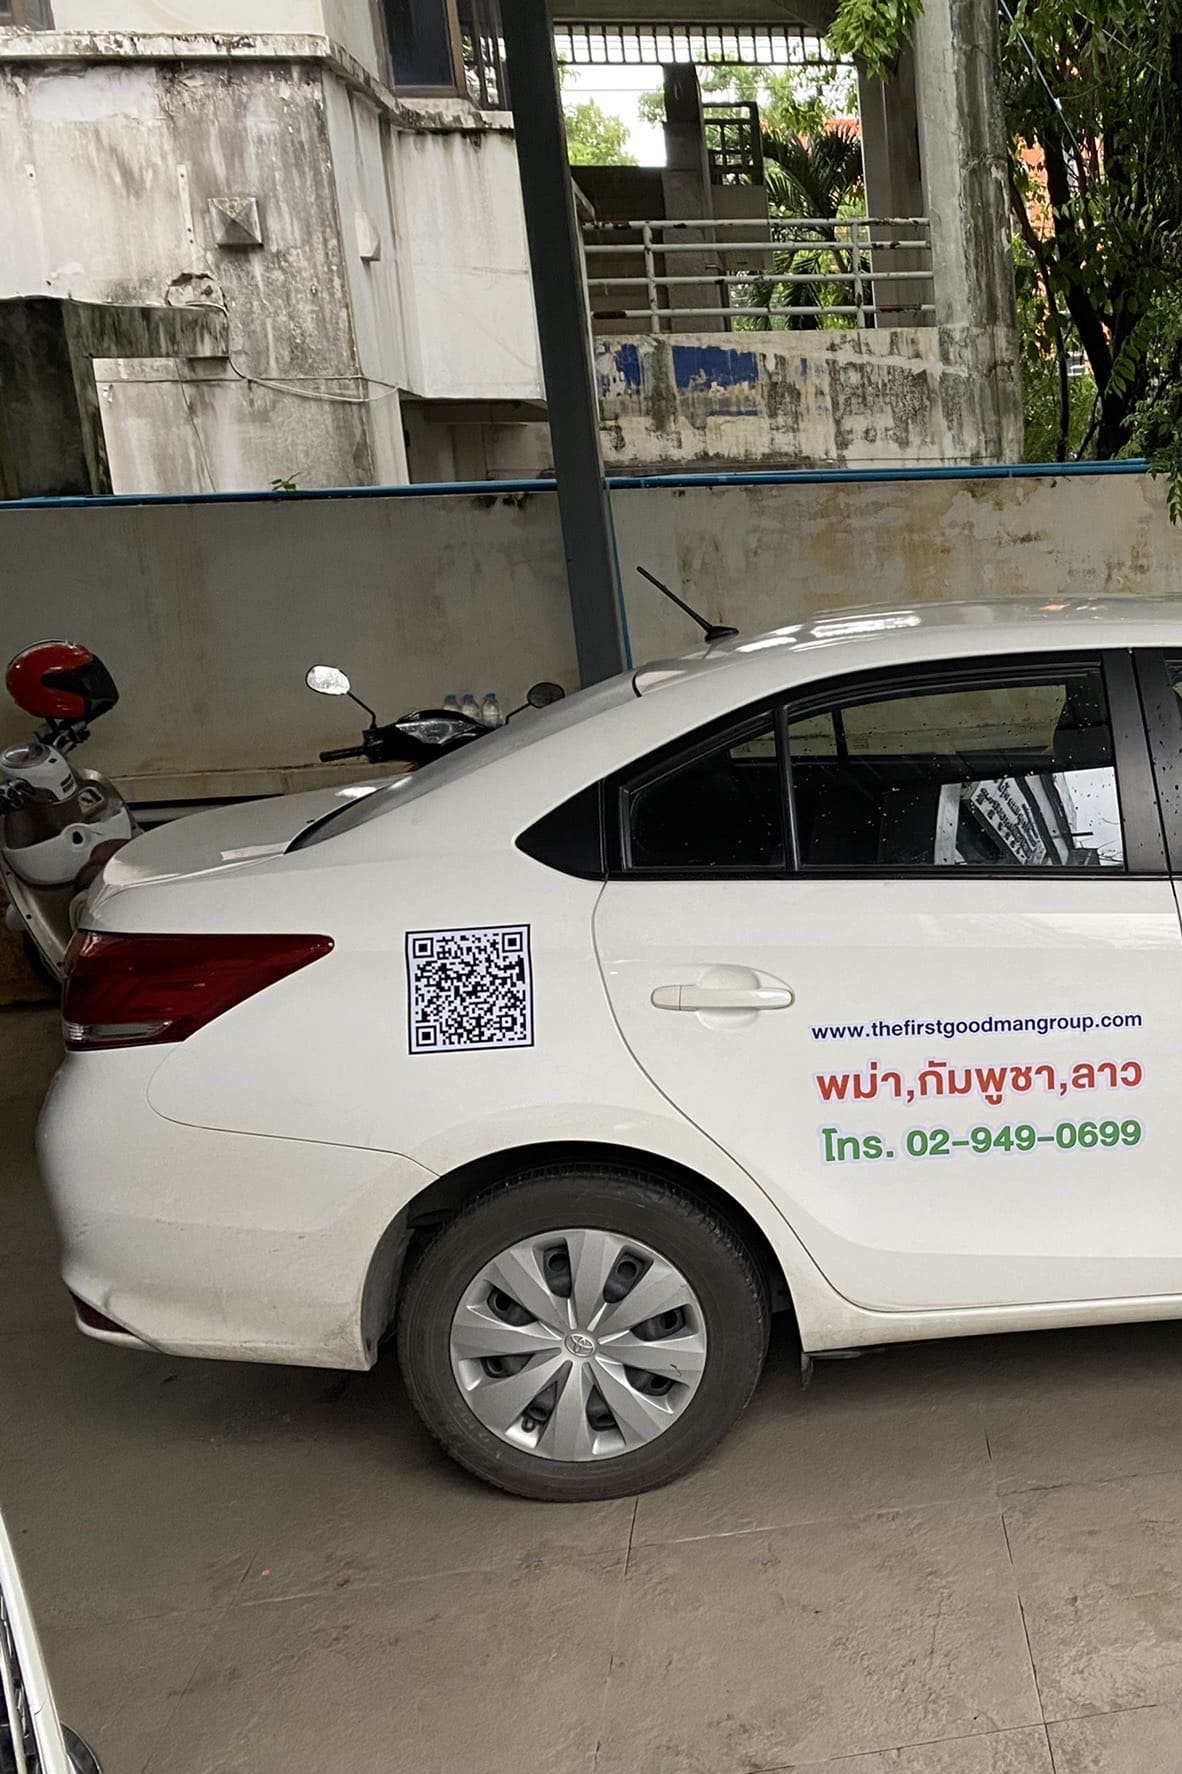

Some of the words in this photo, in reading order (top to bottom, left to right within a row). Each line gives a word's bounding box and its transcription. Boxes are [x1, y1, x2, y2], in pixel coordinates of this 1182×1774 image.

[812, 1012, 1143, 1040] www.thefirstgoodmangroup.com
[816, 1060, 1143, 1106] พม่า,กัมพูชา,ลาว
[822, 1127, 894, 1162] โทร.
[906, 1120, 1142, 1157] 02-949-0699
